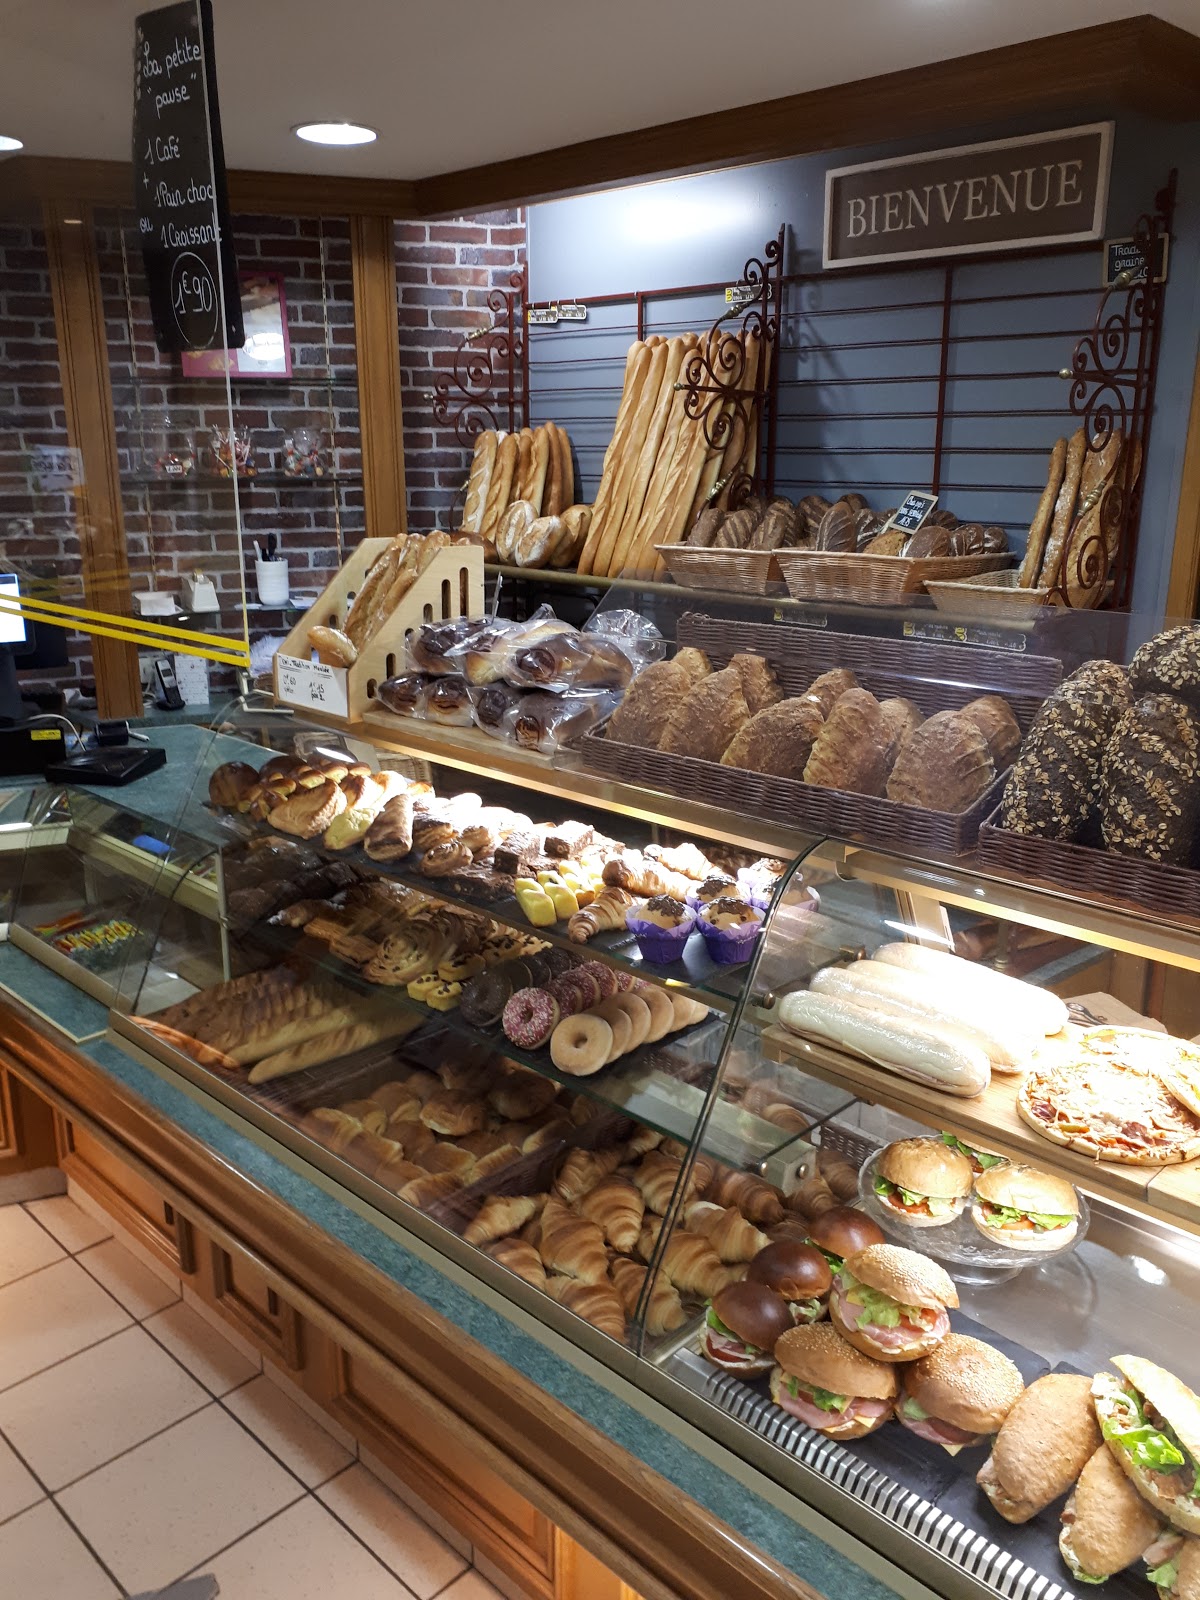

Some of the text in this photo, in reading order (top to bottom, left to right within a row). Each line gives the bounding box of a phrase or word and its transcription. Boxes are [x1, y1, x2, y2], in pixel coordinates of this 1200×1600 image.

[165, 36, 202, 80] petite
[187, 177, 214, 204] choc
[846, 159, 1084, 239] BIENVENUE
[139, 217, 154, 234] ou
